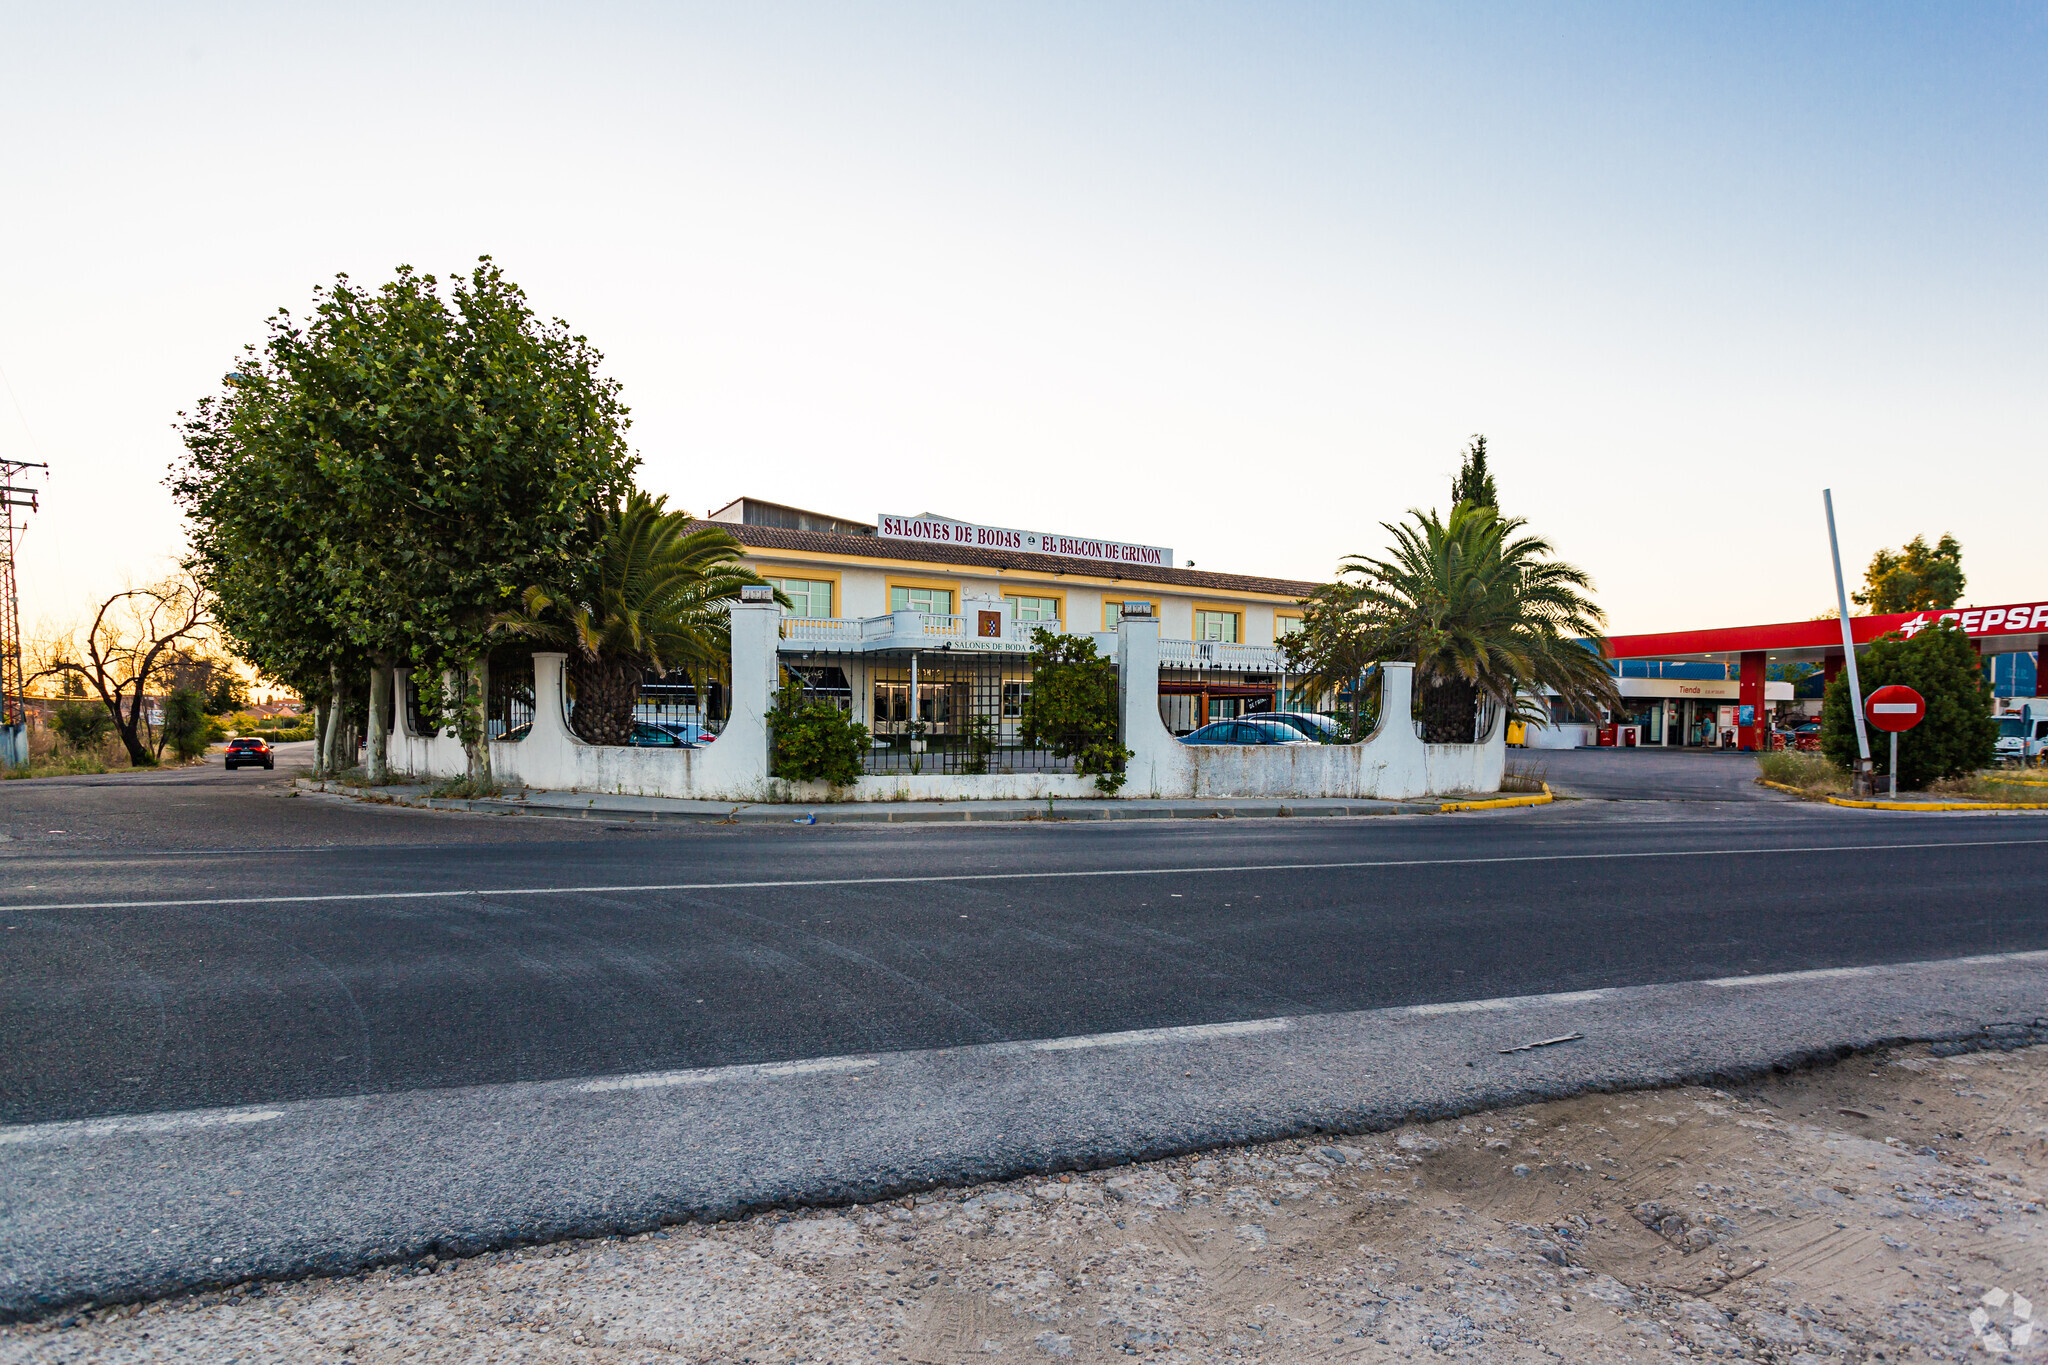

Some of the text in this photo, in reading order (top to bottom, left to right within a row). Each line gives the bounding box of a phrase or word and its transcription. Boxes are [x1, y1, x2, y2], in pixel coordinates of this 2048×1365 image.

[884, 517, 1021, 549] SALONES DE BODAS
[1041, 535, 1057, 553] EL
[1059, 537, 1102, 558] BALCON
[1105, 543, 1119, 560] DE
[954, 641, 1026, 652] SALONES DE BODA
[1679, 685, 1701, 694] Tienda
